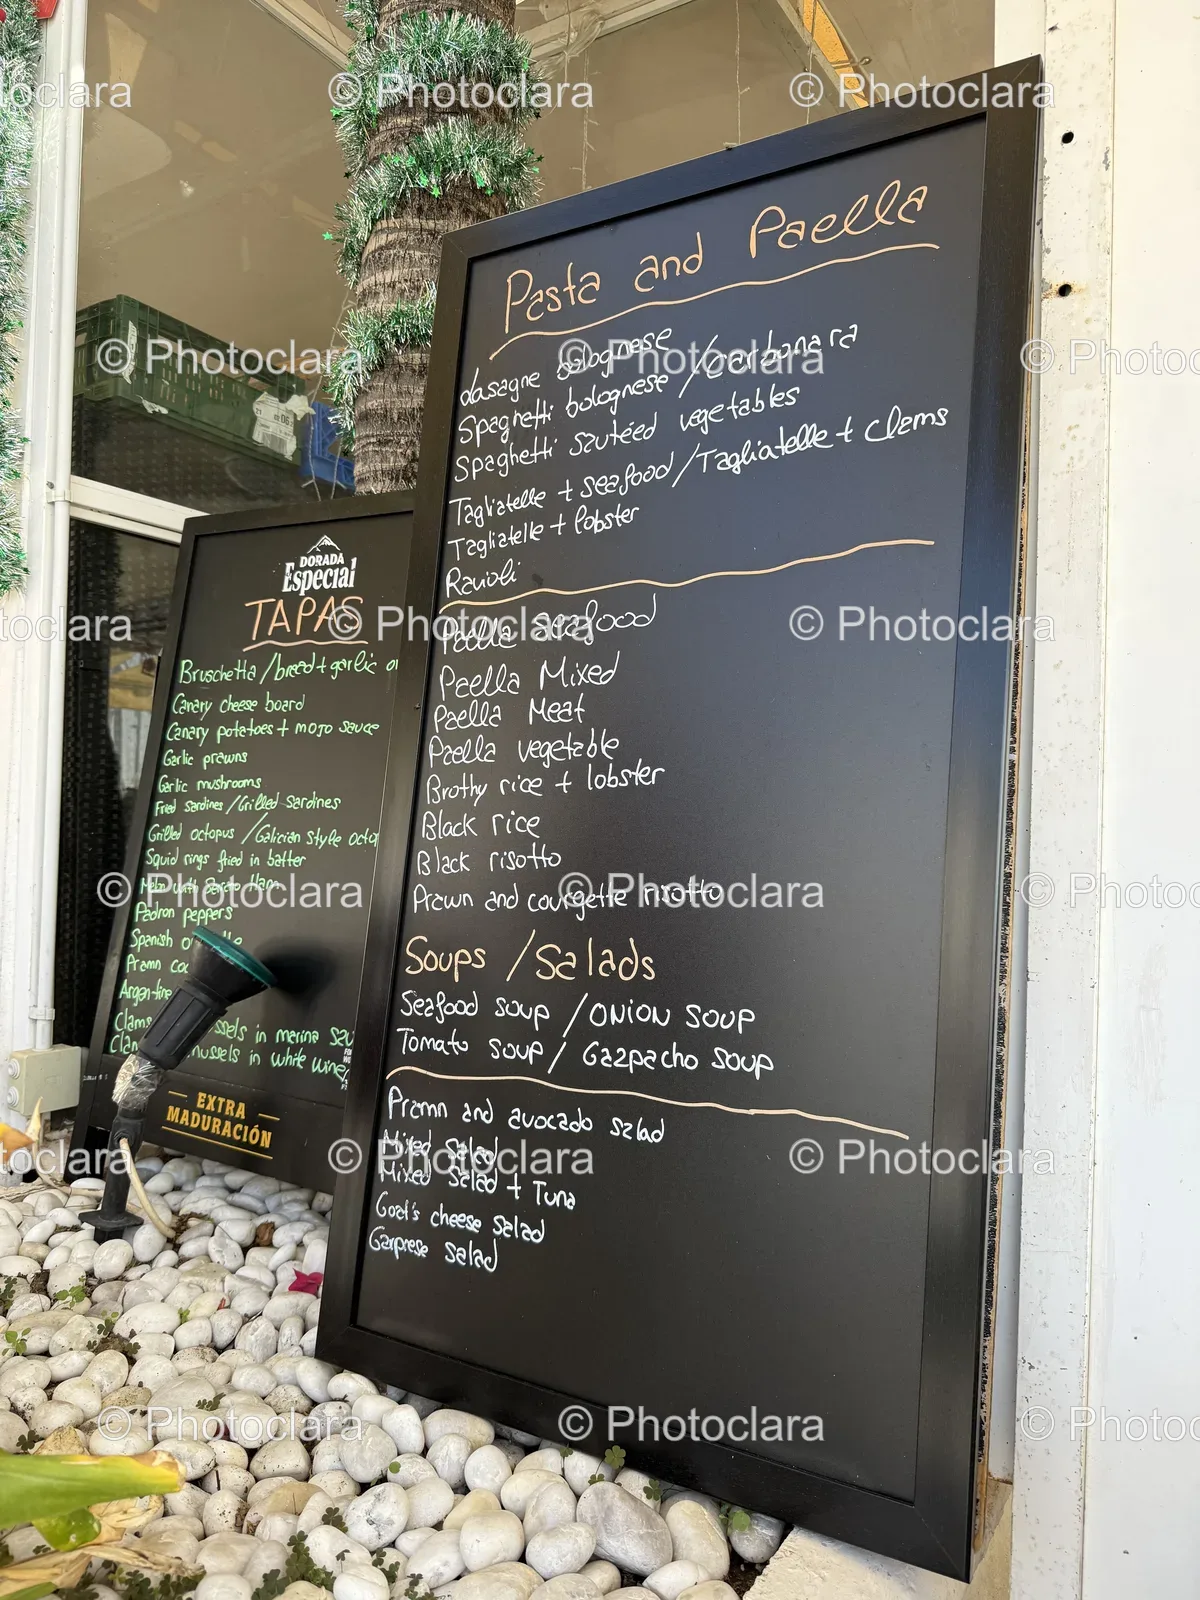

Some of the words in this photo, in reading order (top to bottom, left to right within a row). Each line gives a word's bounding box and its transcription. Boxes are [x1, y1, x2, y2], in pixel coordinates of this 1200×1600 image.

[505, 263, 601, 334] Pasta
[635, 233, 702, 292] and
[749, 179, 928, 258] Paella
[565, 374, 668, 418] bolognese
[454, 438, 558, 482] Spaghetti
[680, 383, 800, 434] vegetables
[449, 487, 546, 527] Tagliatelle
[448, 522, 544, 561] Tagliatelle
[575, 504, 640, 534] lobster
[281, 557, 357, 596] Especial
[300, 553, 345, 568] DORADA
[446, 558, 521, 598] Ravioli
[244, 596, 363, 641] TAPAS
[443, 617, 517, 655] Paella
[179, 659, 257, 684] Bruschetta
[330, 650, 377, 680] garlic
[440, 663, 521, 701] Paella
[540, 650, 621, 691] Mixed
[172, 693, 213, 722] Canary
[219, 694, 258, 713] cheese
[265, 691, 305, 713] board
[434, 700, 501, 734] Paella
[529, 693, 586, 726] Meat
[166, 722, 210, 747] Canary
[217, 717, 273, 744] potatoes
[338, 720, 380, 736] sauce
[429, 734, 497, 769] Paella
[518, 728, 620, 769] vegetable
[163, 749, 194, 767] Garlic
[203, 751, 248, 770] prawns
[158, 774, 188, 793] Garlic
[197, 774, 262, 791] mushrooms
[427, 773, 488, 807] Brothy
[500, 774, 543, 797] rice
[588, 758, 666, 791] lobster
[155, 799, 177, 816] Fried
[148, 823, 182, 843] Grilled
[190, 822, 235, 843] octopus
[421, 809, 478, 841] Black
[492, 810, 541, 838] rice
[145, 847, 179, 871] Squid
[184, 853, 209, 872] rings
[217, 850, 243, 873] fried
[250, 851, 260, 867] in
[267, 848, 306, 868] batter
[417, 846, 471, 876] Black
[490, 842, 562, 873] risotto
[413, 883, 474, 913] Prawn
[484, 883, 518, 911] and
[182, 907, 233, 928] peppers
[130, 928, 173, 952] Spanish
[405, 935, 487, 983] Soups
[400, 990, 479, 1024] Seafood
[255, 1024, 266, 1043] in
[276, 1026, 319, 1044] marina
[397, 1027, 469, 1056] Tomato
[582, 1041, 699, 1073] Gazpacho
[250, 1049, 261, 1067] in
[271, 1046, 306, 1069] white
[196, 1091, 246, 1120] EXTRA
[462, 1098, 493, 1124] and
[508, 1107, 593, 1133] avocado
[166, 1105, 273, 1149] MADURACIÓN
[532, 1180, 576, 1211] Tuna
[430, 1203, 482, 1234] cheese
